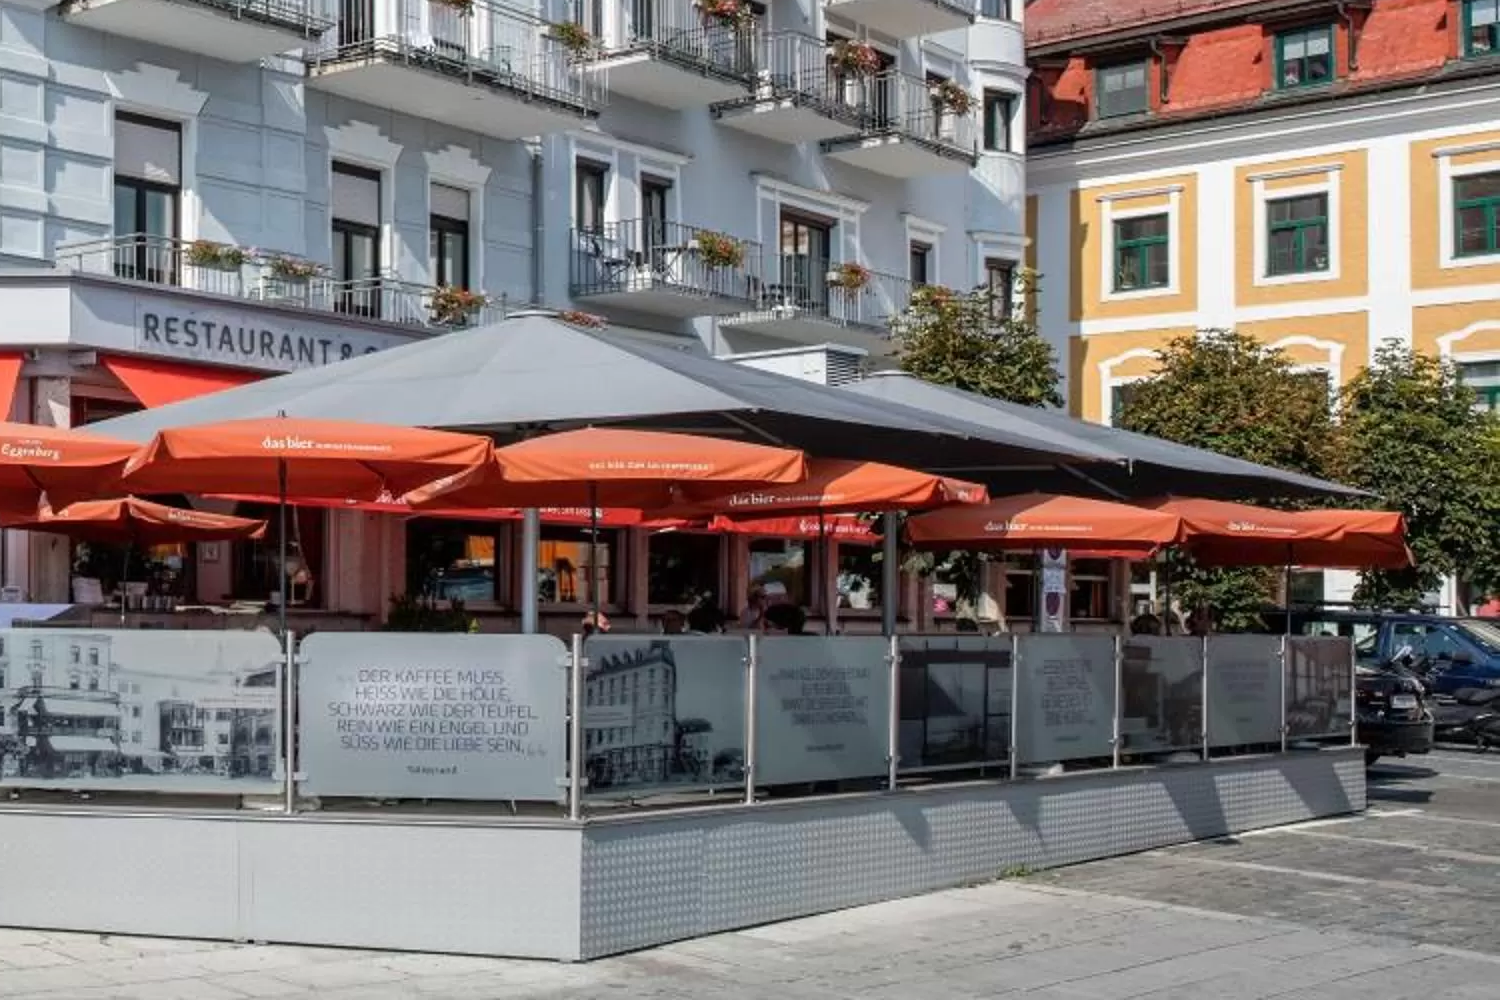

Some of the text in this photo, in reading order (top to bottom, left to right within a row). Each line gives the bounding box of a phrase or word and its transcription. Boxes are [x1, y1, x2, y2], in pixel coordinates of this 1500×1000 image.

[143, 313, 332, 365] RESTAURANT
[357, 669, 505, 684] DER KAFFEE MUSS
[328, 702, 406, 717] SCHWARZ
[409, 703, 439, 718] WIE
[443, 703, 474, 718] DER
[337, 719, 374, 734] REIN
[376, 720, 406, 735] WIE
[409, 720, 435, 735] EIN
[439, 720, 488, 735] ENGEL
